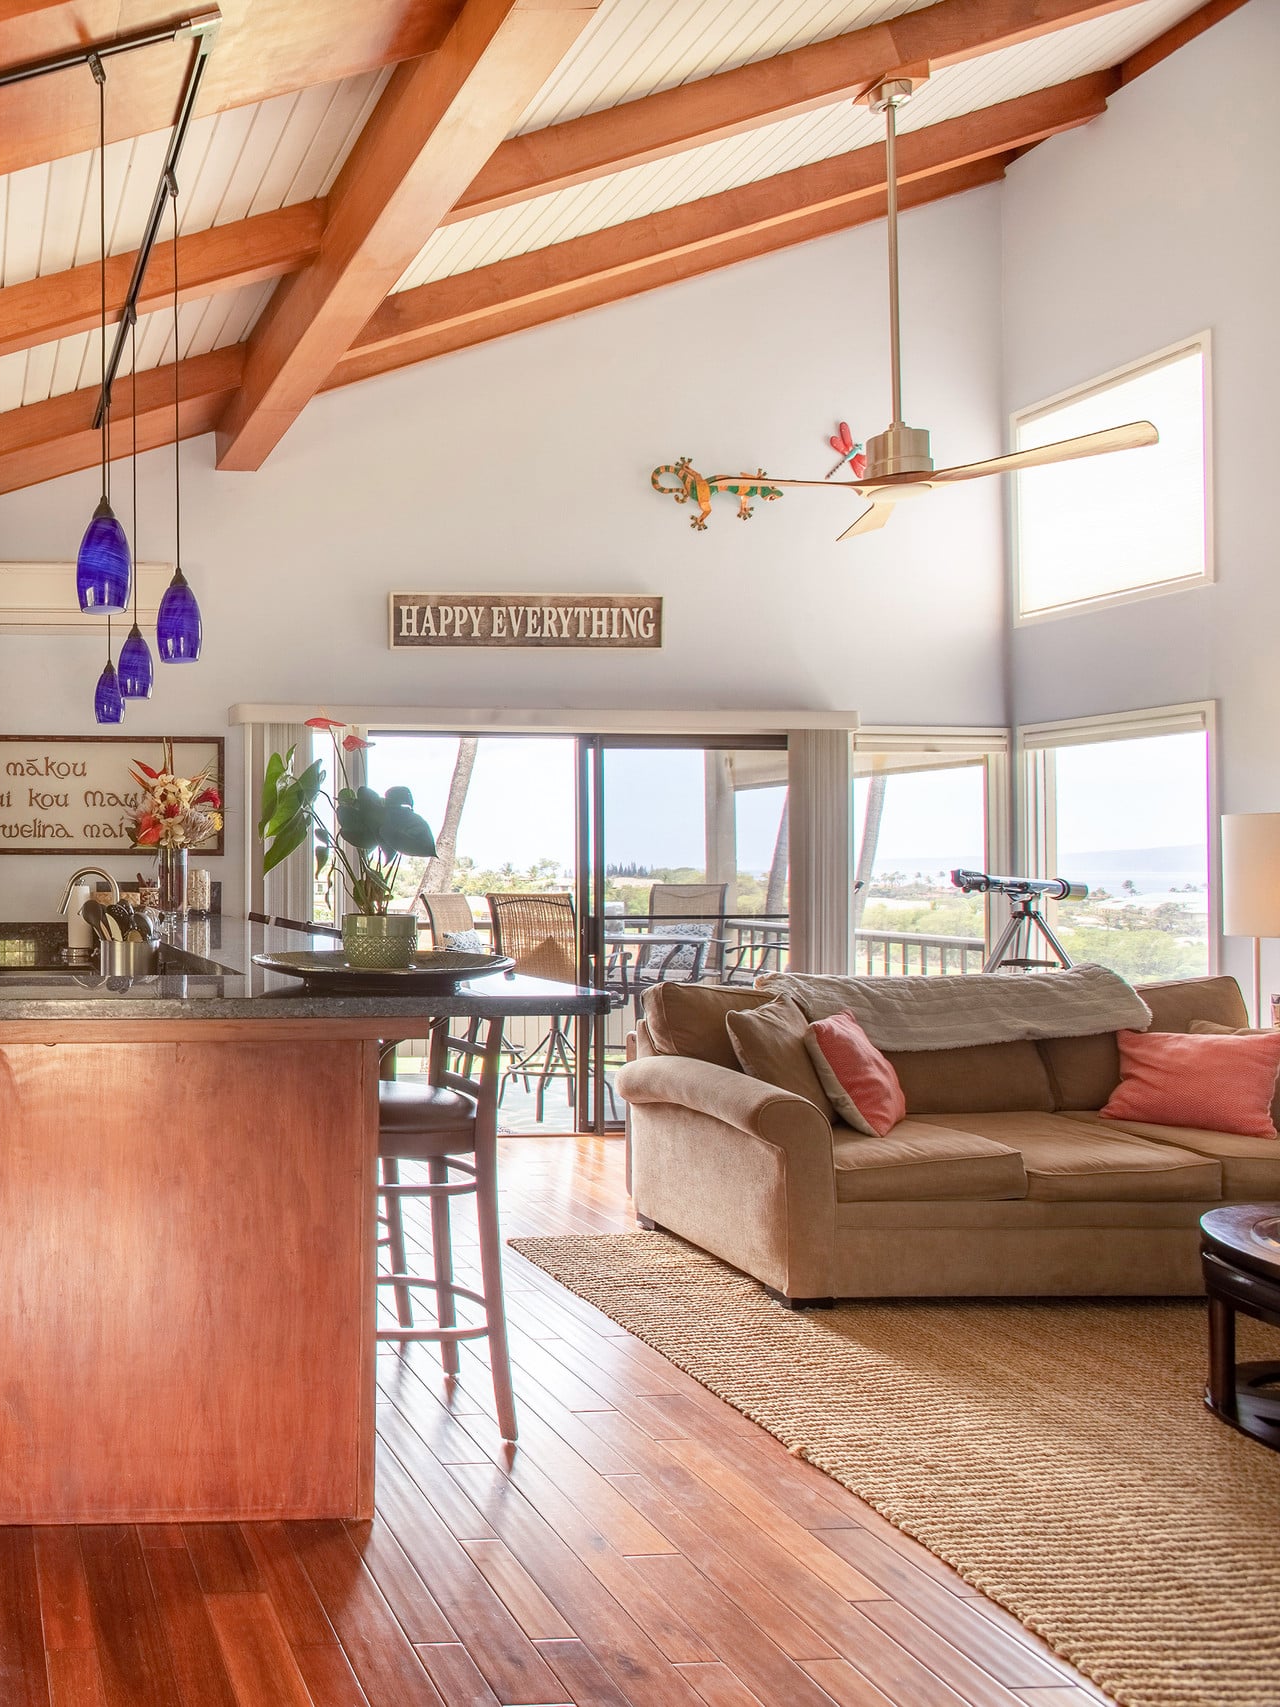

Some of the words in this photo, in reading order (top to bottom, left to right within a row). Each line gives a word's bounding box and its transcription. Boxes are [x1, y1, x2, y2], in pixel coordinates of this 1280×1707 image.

[399, 605, 484, 637] HAPPY
[491, 606, 655, 638] EVERYTHING
[6, 756, 87, 779] mākou
[28, 788, 70, 810] kou
[84, 790, 144, 808] Mau
[0, 819, 73, 838] welina
[83, 816, 126, 838] mai
